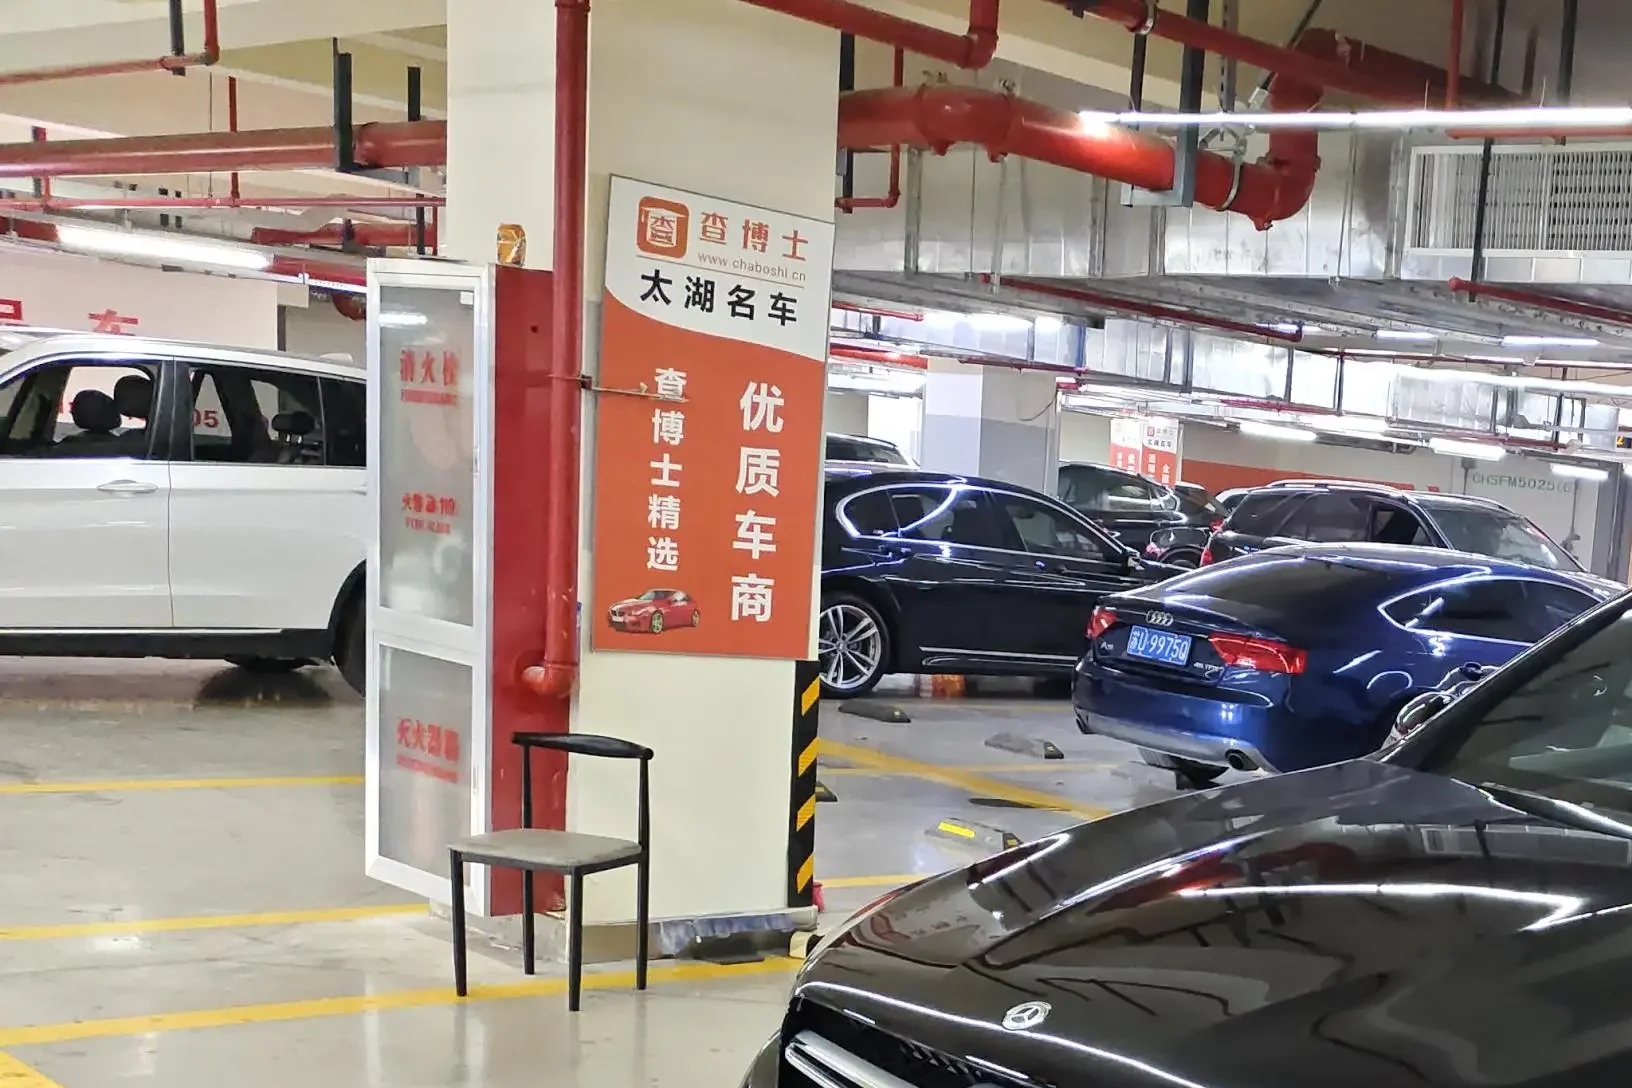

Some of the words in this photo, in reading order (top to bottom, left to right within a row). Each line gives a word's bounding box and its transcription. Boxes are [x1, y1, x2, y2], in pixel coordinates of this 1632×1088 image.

[699, 211, 808, 262] 查博士
[697, 252, 807, 283] www.chaboshi.cn
[639, 268, 798, 327] 太湖名车
[647, 367, 688, 572] 查博士精选
[730, 380, 785, 623] 优质车商
